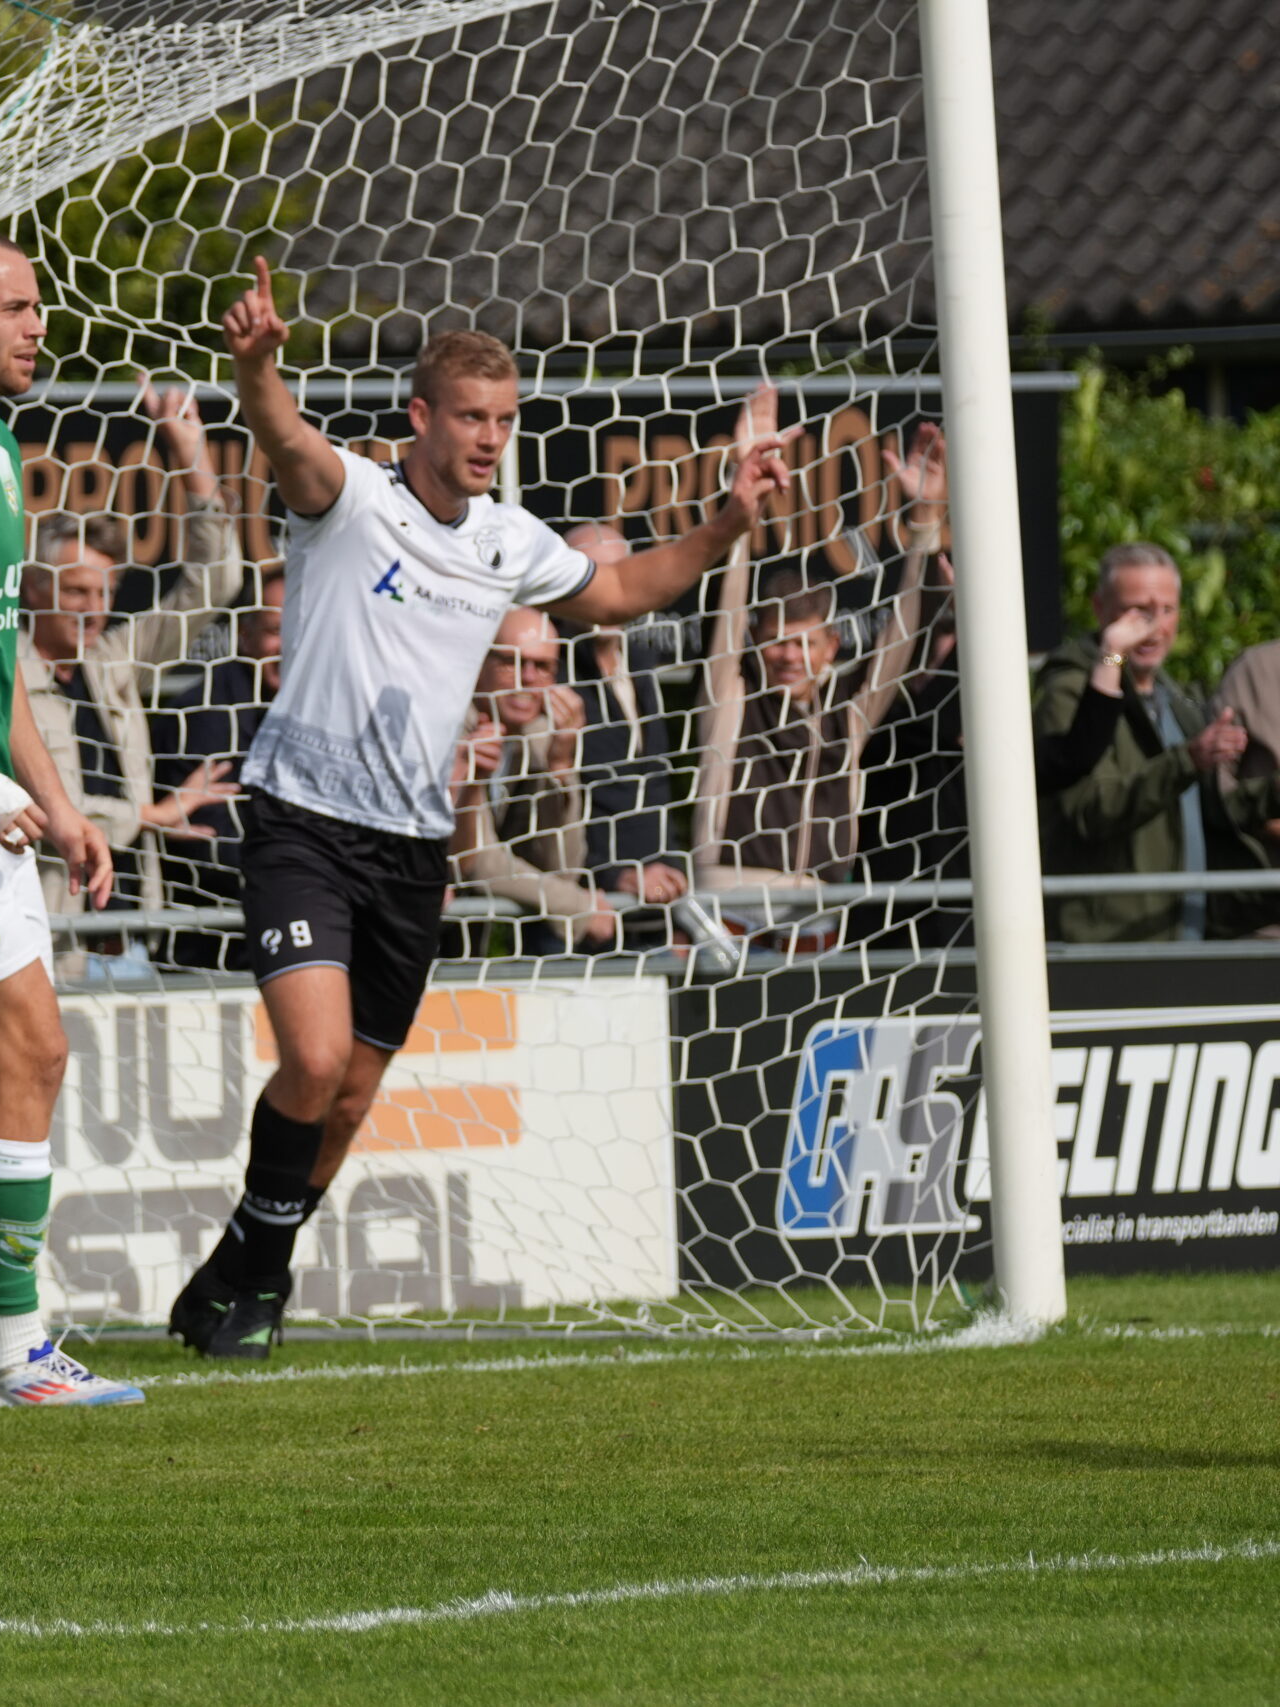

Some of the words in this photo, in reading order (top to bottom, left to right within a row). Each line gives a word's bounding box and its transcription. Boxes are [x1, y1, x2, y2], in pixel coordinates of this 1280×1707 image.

[289, 920, 313, 949] 9
[1062, 1212, 1114, 1245] cialist
[1114, 1211, 1136, 1243] in
